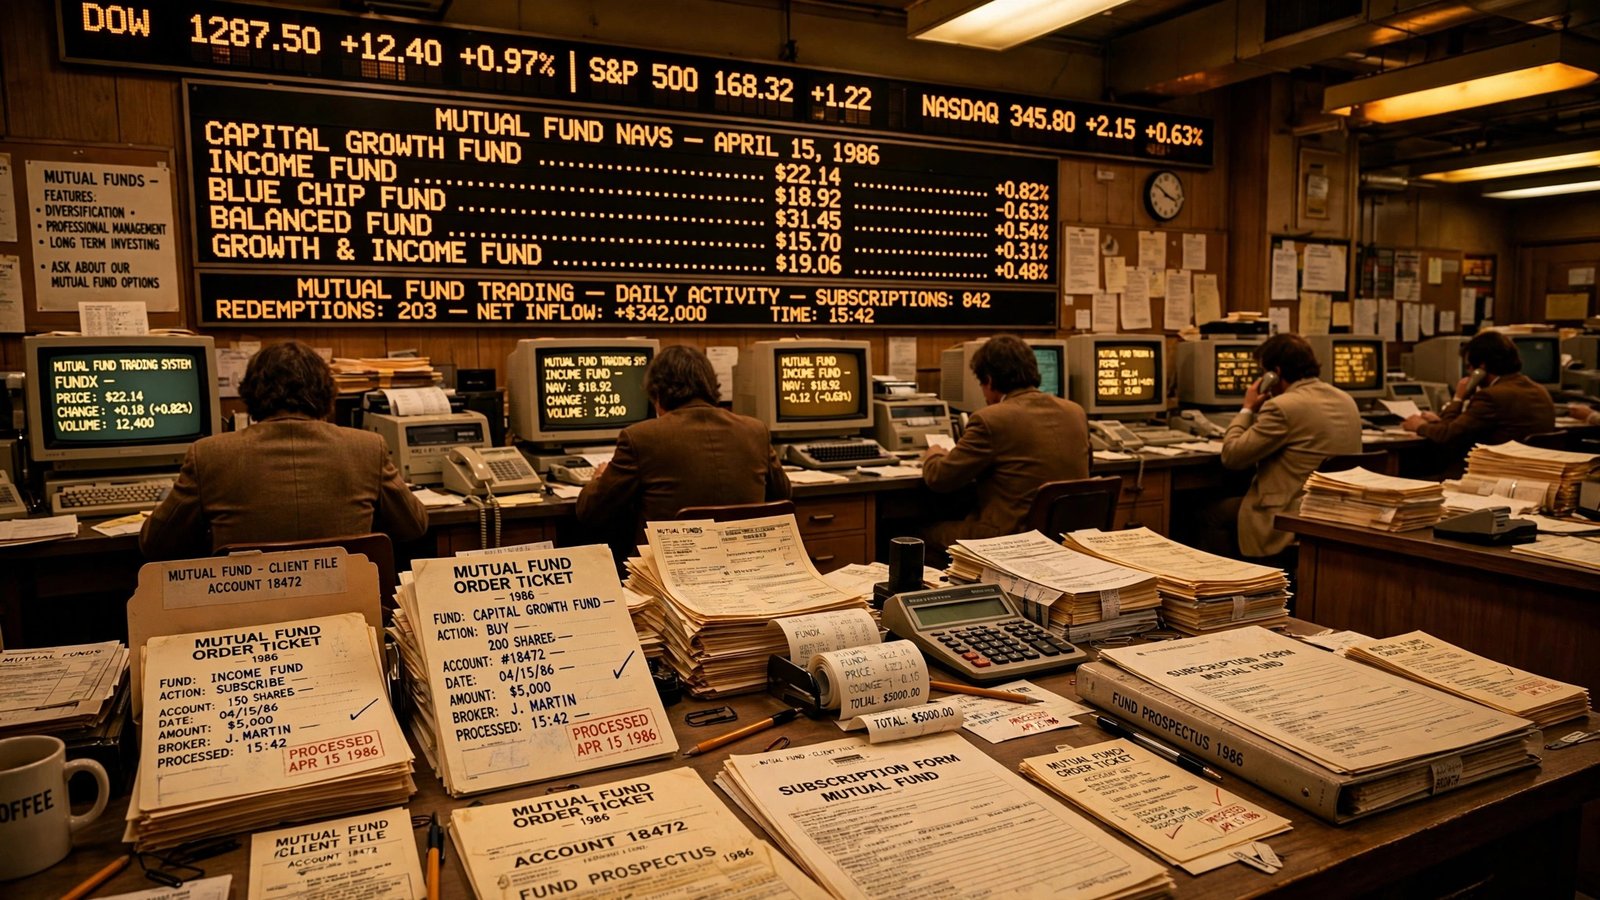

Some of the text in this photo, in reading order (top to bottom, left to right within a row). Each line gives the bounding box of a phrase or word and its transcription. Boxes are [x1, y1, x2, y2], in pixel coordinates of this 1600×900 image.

[82, 2, 1203, 147] DOW 1287.50 +12.40 +0.97% S&P 500 168.32 +1.22 NASDAQ 345.80 +2.15 +0.63%
[435, 107, 879, 165] MUTUAL FUND NAVS APRIL 15, 1986
[205, 121, 1049, 201] CAPITAL GROWTH FUND $22.14 +0.82%
[44, 170, 145, 187] MUTUAL FUNDS
[209, 149, 1049, 220] INCOME FUND $18.92 -0.63%
[44, 189, 97, 202] FEATURES:
[45, 205, 125, 218] DIVERSIFICATION
[208, 177, 1049, 240] BLUE CHIP FUND $31.45 +0.54%
[46, 221, 166, 235] PROFESSIONAL MANAGEMENT
[211, 206, 1049, 261] BALANCED FUND $15.70 +0.31%
[50, 237, 160, 250] LONG TERM INVESTING
[51, 261, 130, 273] ASK ABOUT OUR
[212, 234, 1049, 281] GROWTH & INCOME FUND $19.06 +0.48%
[51, 276, 160, 289] MUTUAL FUND OPTIONS
[298, 279, 990, 309] MUTUAL FUND TRADING DAILY ACTIVITY SUBSCRIPTIONS: 842
[216, 300, 874, 324] REDEMPTIONS: 203 NET INFLOW: +$342,000 TIME: 15:42
[54, 358, 192, 373] MUTUAL FUND TRADING SYSTEM
[781, 356, 837, 367] MUTUAL FUND
[55, 375, 99, 389] FUNDX
[545, 382, 612, 394] NAV: $18.92
[782, 380, 840, 391] NAV: $18.92
[56, 391, 143, 404] PRICE: $22.14
[547, 405, 627, 418] VOLUME: 12,400
[58, 417, 154, 432] VOLUME: 12,400
[168, 557, 338, 582] MUTUAL FUND CLIENT FILE
[454, 557, 572, 578] MUTUAL FUND
[208, 577, 302, 594] ACCOUNT 18472
[454, 571, 573, 594] ORDER TICKET
[434, 597, 601, 625] FUND: CAPITAL GROWTH FUND
[195, 625, 321, 649] MUTUAL FUND
[437, 623, 509, 641] ACTION: BUY
[2, 655, 54, 663] MUTUAL
[192, 636, 322, 661] ORDER TICKET
[443, 649, 546, 672] ACCOUNT: #18472
[159, 663, 303, 688] FUND: INCOME FUND
[445, 665, 554, 689] DATE: 04/15/86
[159, 677, 285, 701] ACTION: SUBSCRIBE
[158, 715, 273, 740] AMOUNT: $5,000
[456, 712, 569, 742] PROCESSED: 15:42
[572, 713, 649, 741] PROCESSED
[873, 716, 908, 729] TOTAL:
[912, 707, 954, 723] $5000.00
[1112, 692, 1244, 767] FUND PROSPECTUS 1986
[289, 734, 373, 760] PROCESSED
[577, 729, 657, 757] APR 15 1986
[778, 754, 961, 796] SUBSCRIPTION FORM
[821, 771, 939, 802] MUTUAL FUND
[511, 782, 651, 818] MUTUAL FUND
[513, 792, 655, 829] ORDER TICKET
[580, 813, 610, 826] 1986
[276, 820, 389, 847] MUTUAL FUND
[514, 836, 615, 868] ACCOUNT
[627, 821, 688, 841] 18472
[519, 879, 578, 899] FUND
[588, 846, 716, 885] PROSPECTUS
[723, 848, 755, 863] 1986
